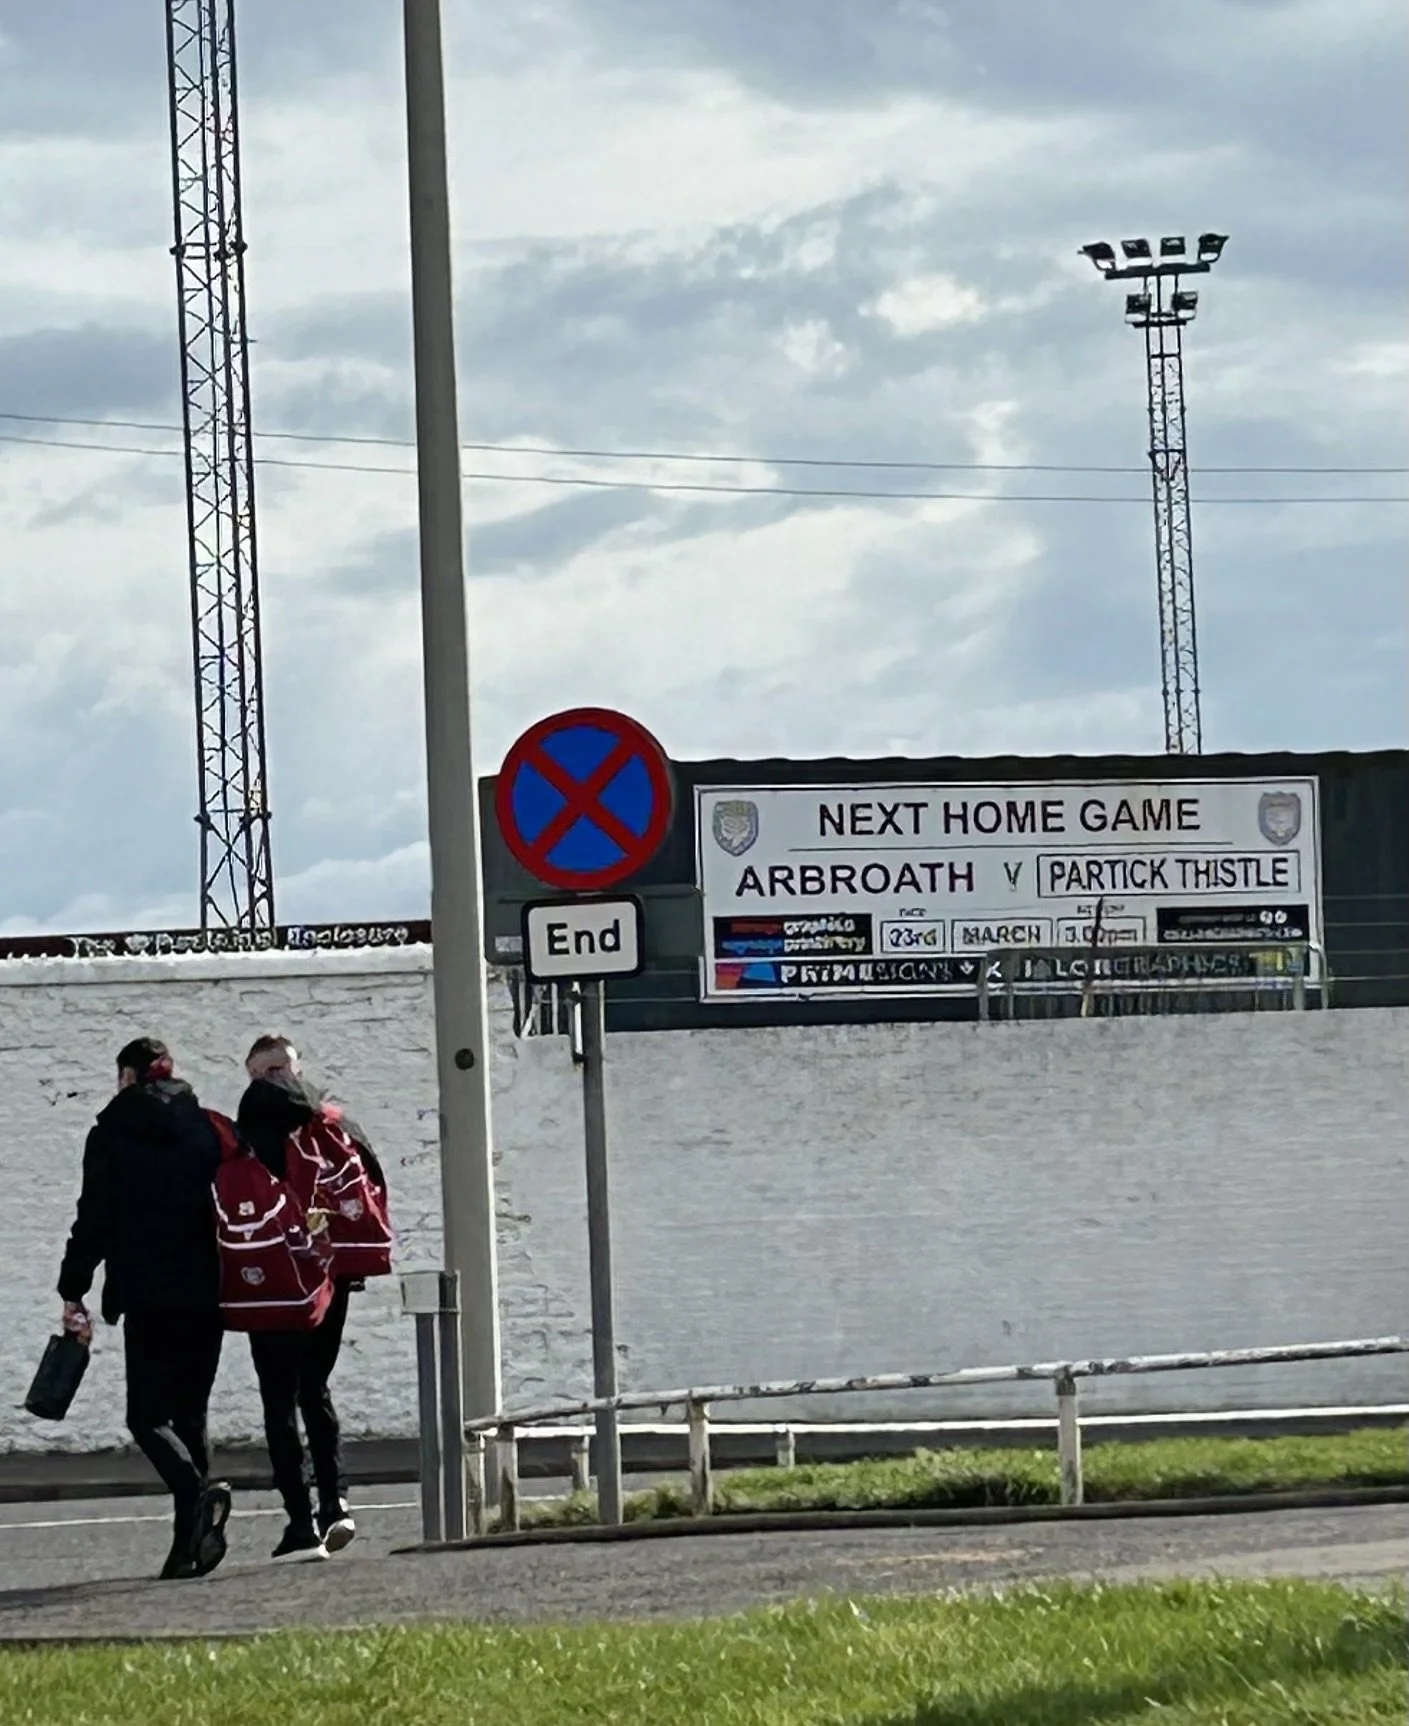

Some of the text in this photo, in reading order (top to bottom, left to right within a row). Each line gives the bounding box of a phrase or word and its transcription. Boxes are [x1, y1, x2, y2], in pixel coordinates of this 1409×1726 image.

[819, 798, 1201, 836] NEXT HOME GAME
[735, 861, 974, 897] ARBROATH
[1050, 857, 1168, 892] PARTICK
[1176, 856, 1289, 889] THISTLE
[547, 918, 621, 956] End
[962, 924, 1041, 946] MARCH
